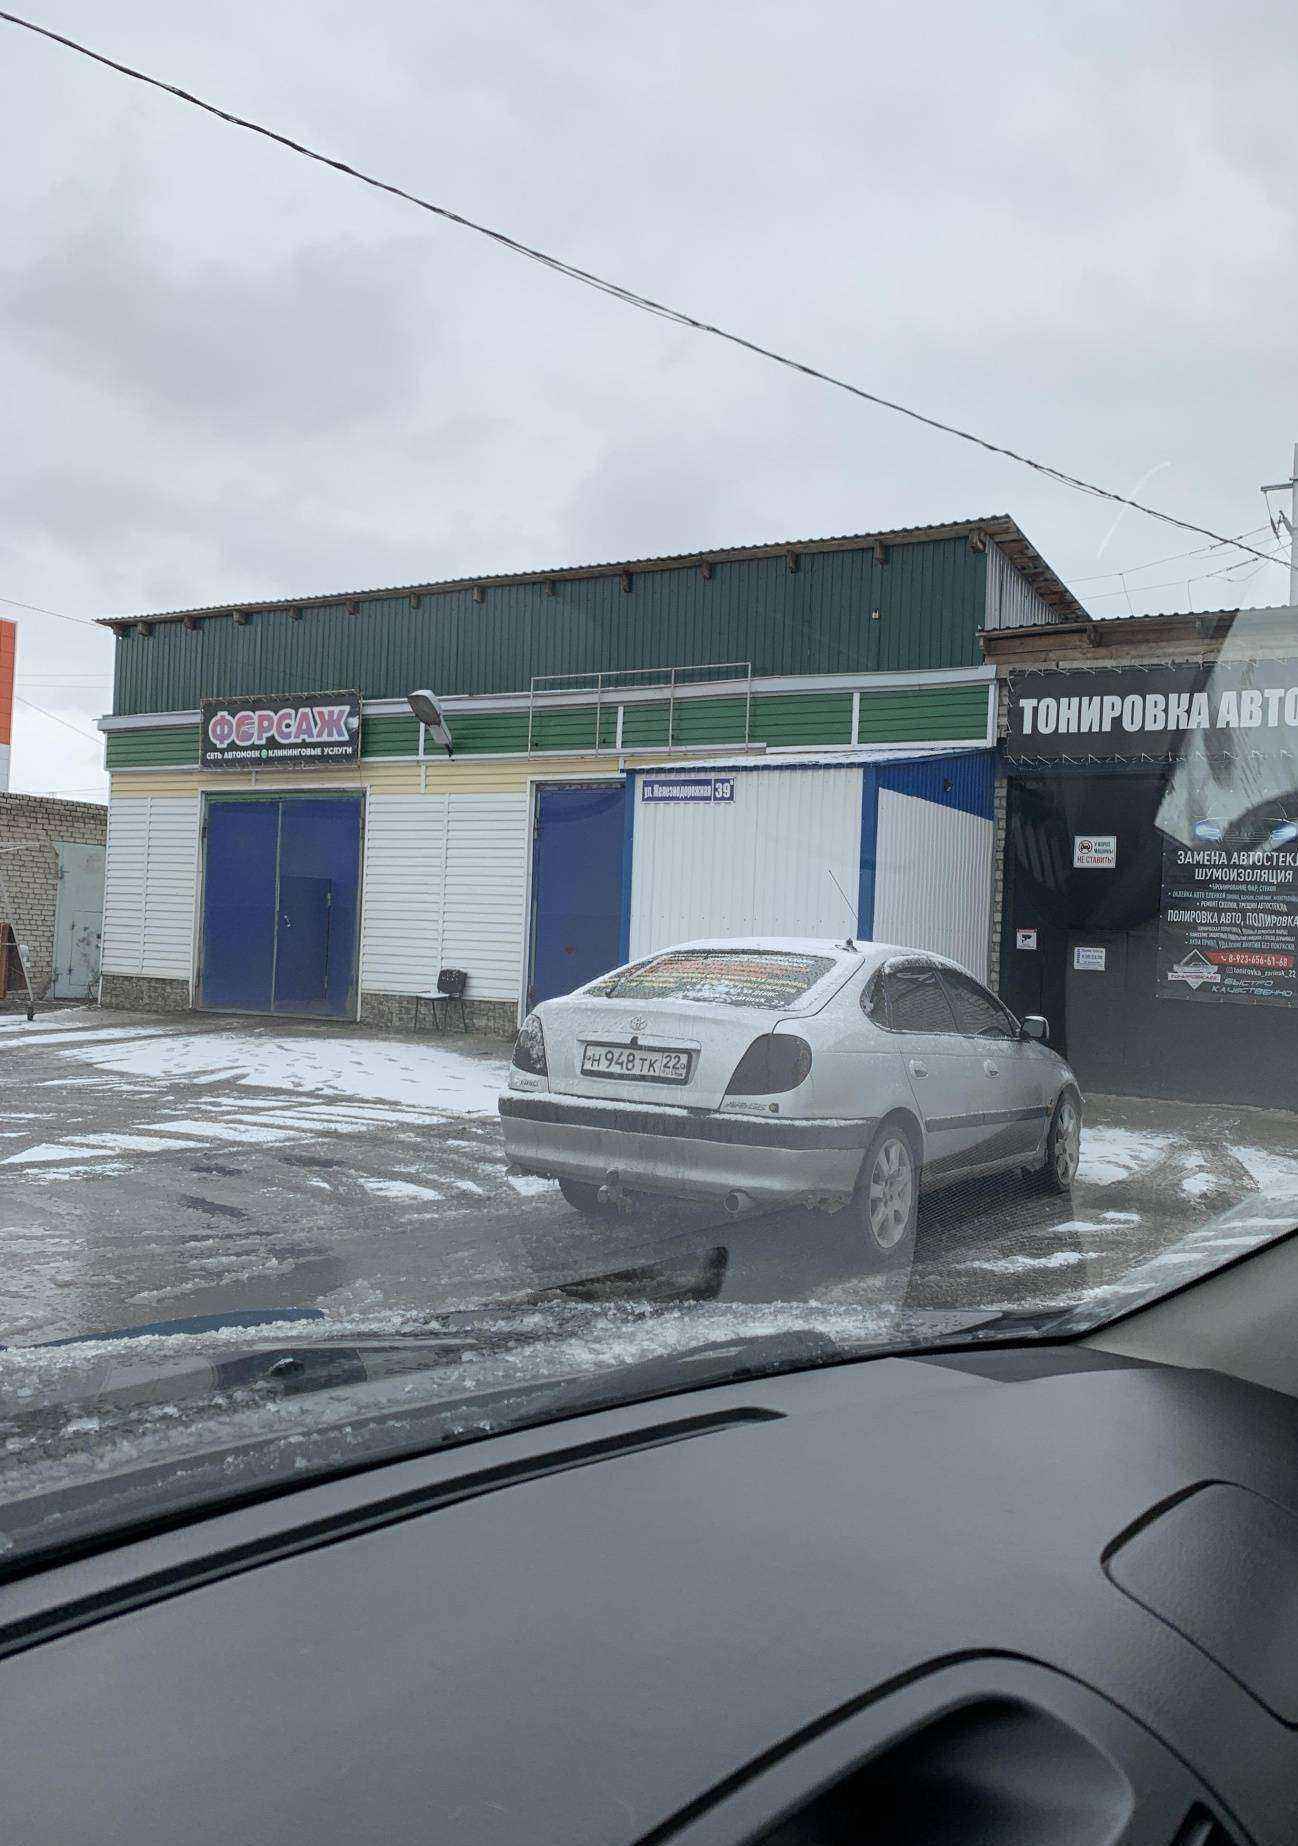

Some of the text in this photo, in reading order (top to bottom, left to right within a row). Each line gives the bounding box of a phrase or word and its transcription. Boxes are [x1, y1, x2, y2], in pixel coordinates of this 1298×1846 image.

[1019, 692, 1210, 735] ТОНИРОВКА
[206, 746, 352, 760] СЕТЬ АВТОМОЕК КЛИНИНГОВЫЕ УСЛУГИ
[1178, 851, 1227, 865] ЗАМЕНА
[1195, 868, 1293, 884] ШУМОИЗОЛЯЦИЯ
[1168, 910, 1218, 924] ПОЛИРОВКА
[1220, 913, 1244, 926] АВТО,
